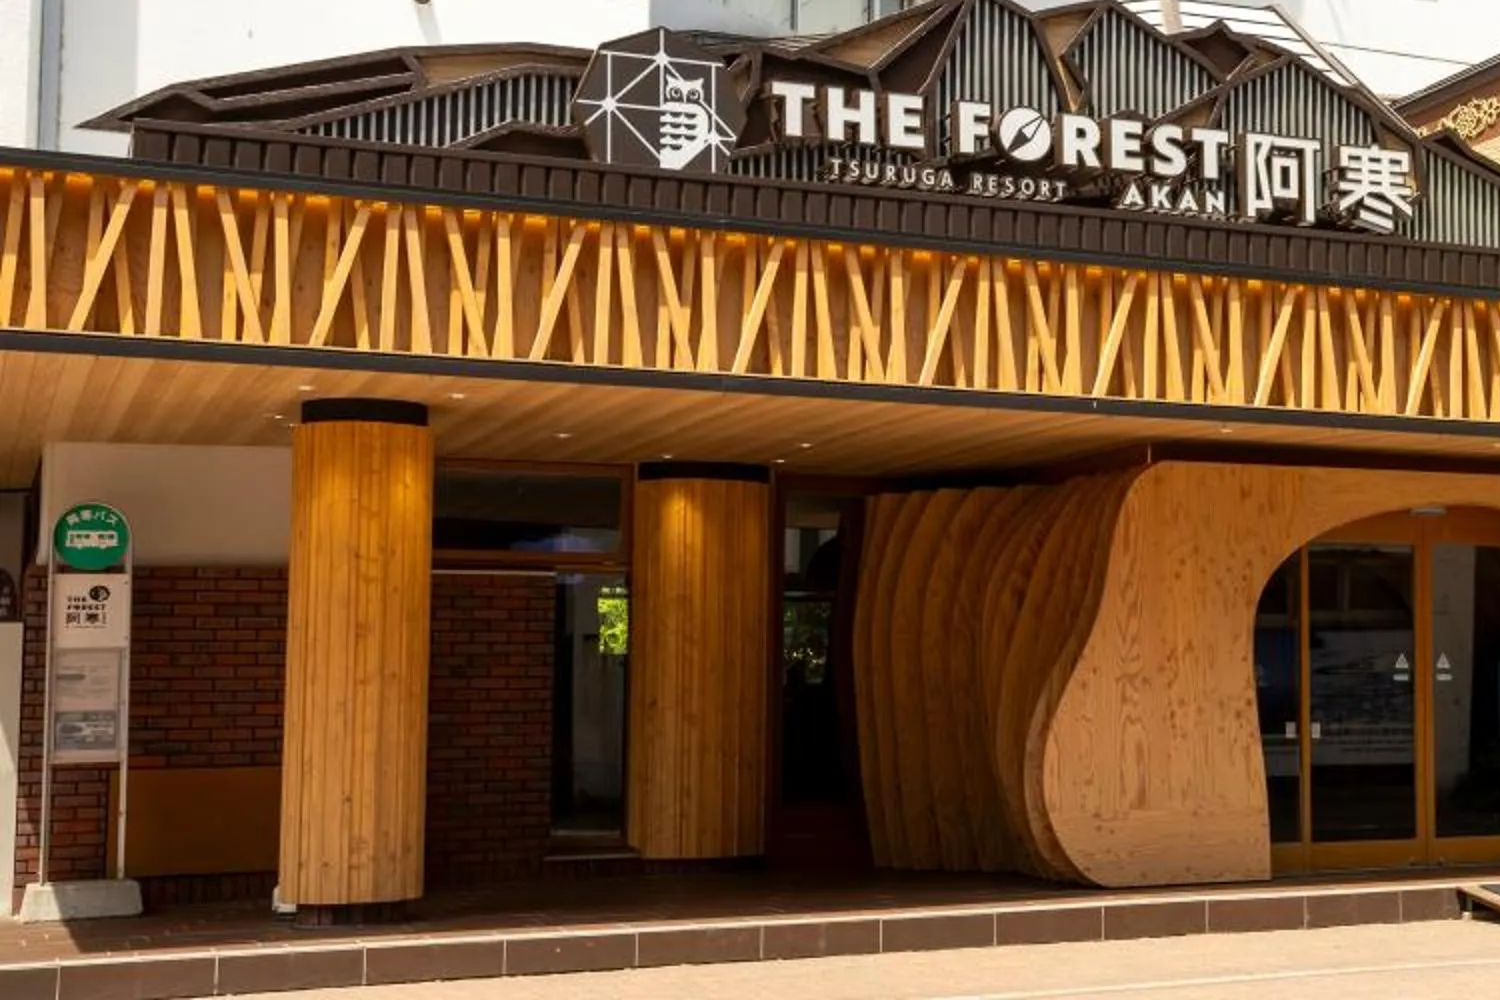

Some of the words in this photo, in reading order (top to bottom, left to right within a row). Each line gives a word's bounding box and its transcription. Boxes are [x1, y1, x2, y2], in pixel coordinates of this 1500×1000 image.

[771, 80, 925, 148] THE
[957, 100, 1229, 180] FOREST
[830, 158, 953, 188] TSURUGA
[972, 172, 1067, 200] RESORT
[1122, 181, 1226, 214] AKAN
[1246, 131, 1413, 234] 阿寒
